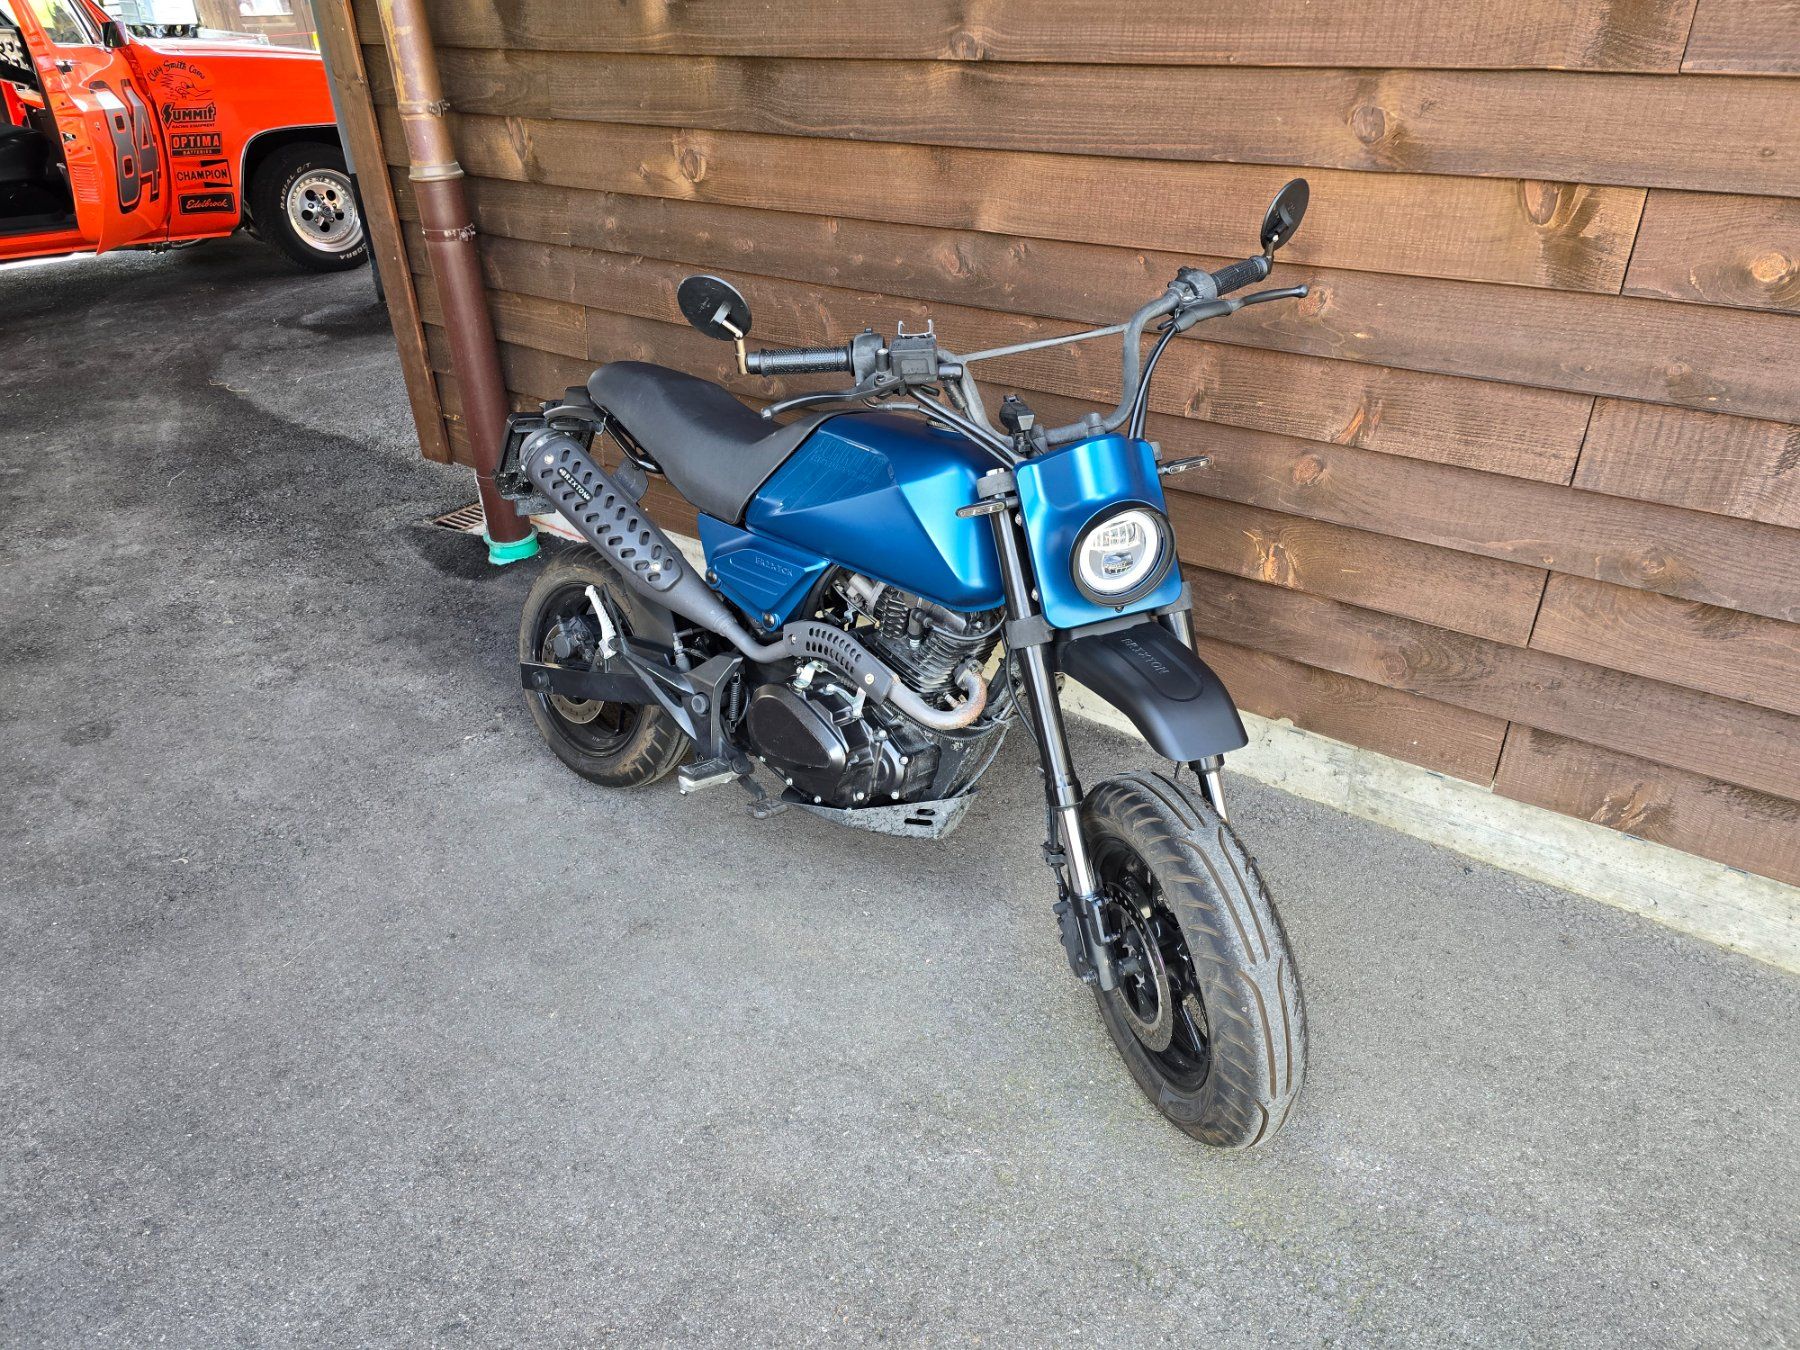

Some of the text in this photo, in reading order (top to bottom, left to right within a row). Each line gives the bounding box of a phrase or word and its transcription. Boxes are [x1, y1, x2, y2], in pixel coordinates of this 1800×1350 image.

[163, 60, 187, 72] Smith
[89, 80, 161, 214] 84
[172, 135, 220, 148] OPTIMA
[176, 169, 228, 181] CHAMPION
[280, 175, 296, 210] RADIAL
[185, 198, 229, 209] Edelbrock
[560, 469, 590, 500] BRIXTON
